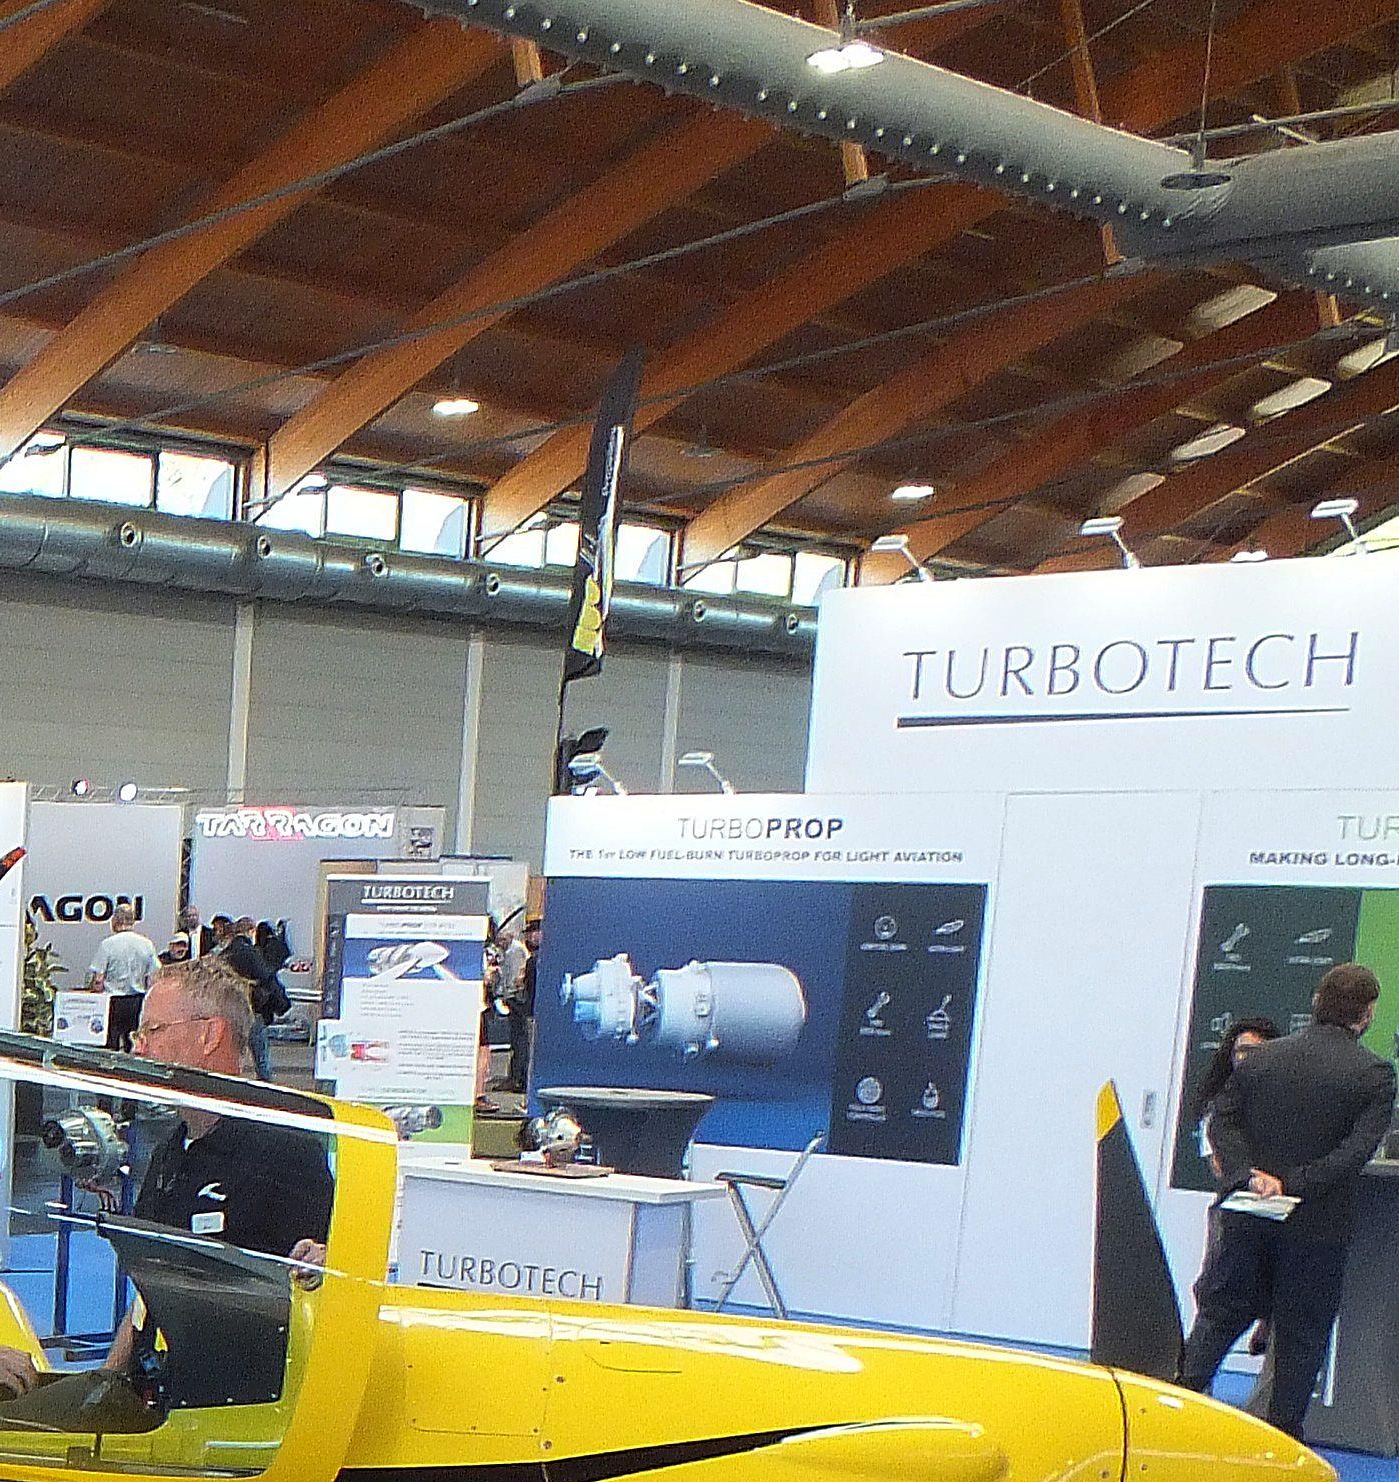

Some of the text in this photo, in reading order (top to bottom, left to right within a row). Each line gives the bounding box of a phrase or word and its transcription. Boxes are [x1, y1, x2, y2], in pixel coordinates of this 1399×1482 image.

[903, 631, 1359, 701] TURBOTECH
[196, 811, 394, 837] TARRAGON
[677, 817, 843, 840] TURBOPROP
[569, 849, 593, 860] THE
[728, 850, 810, 862] TURBOPROP
[814, 851, 841, 862] FOR
[846, 851, 890, 863] LIGHT
[893, 851, 964, 863] AVIATION
[1250, 852, 1399, 866] MAKING LONG-
[363, 885, 454, 899] TURBOTECH
[30, 895, 143, 922] AGON
[421, 1250, 601, 1300] TURBOTECH
